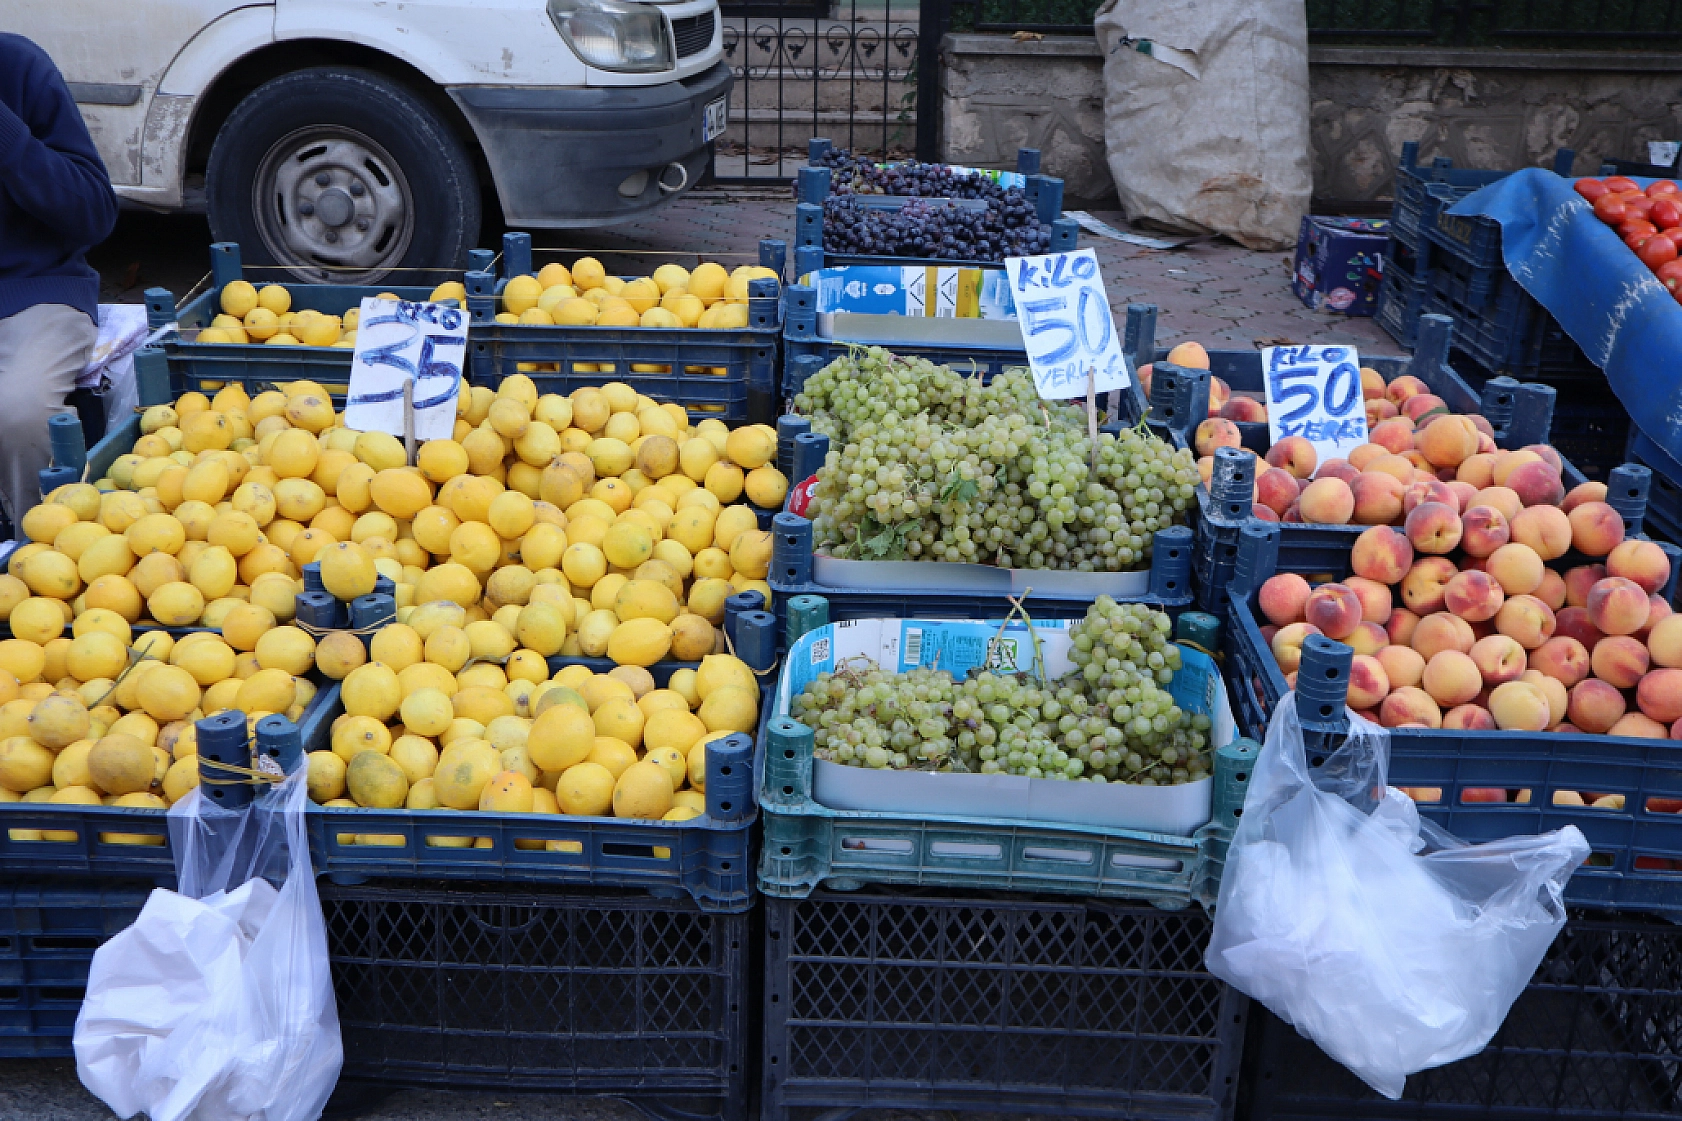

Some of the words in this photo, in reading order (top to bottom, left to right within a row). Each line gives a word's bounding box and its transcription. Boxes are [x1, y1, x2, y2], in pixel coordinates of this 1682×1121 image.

[347, 314, 467, 410] 35
[1020, 286, 1111, 366] 50
[1268, 363, 1360, 421] 50
